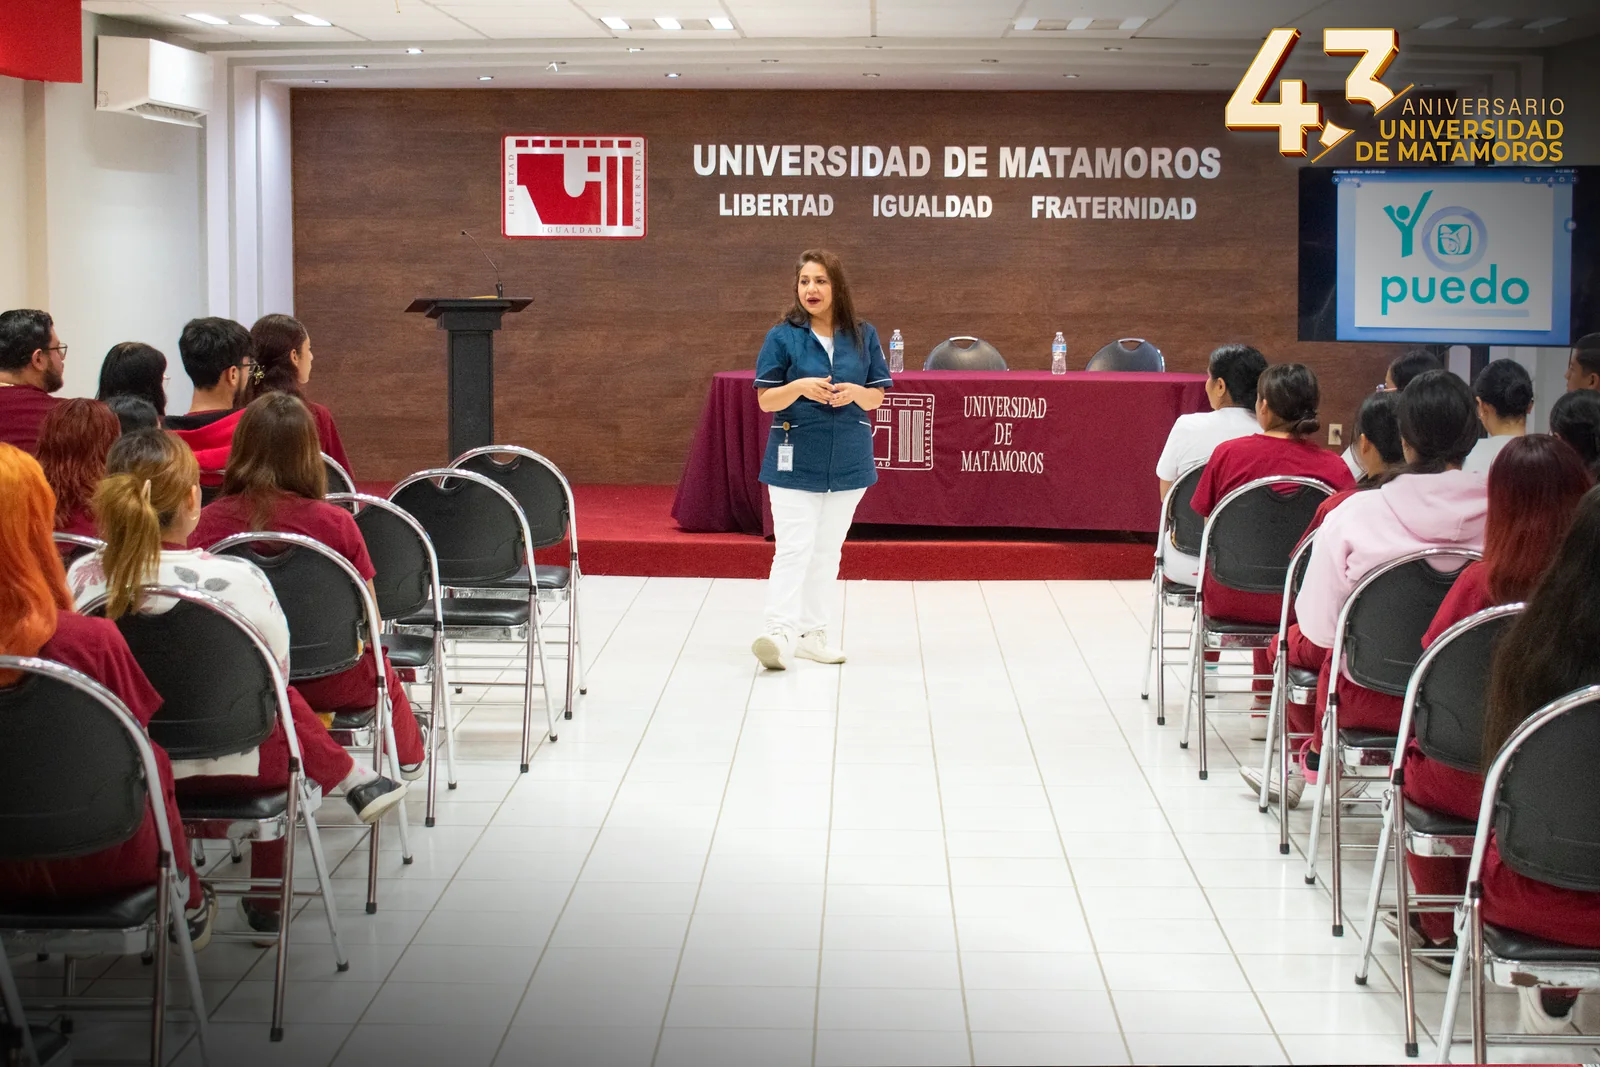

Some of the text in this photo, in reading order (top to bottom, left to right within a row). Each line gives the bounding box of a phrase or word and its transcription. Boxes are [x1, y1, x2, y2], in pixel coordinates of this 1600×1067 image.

[693, 144, 1222, 180] UNIVERSIDAD DE MATAMOROS
[719, 193, 1197, 220] LIBERTAD IGUALDAD FRATERNIDAD
[542, 226, 602, 234] IGUALDAD
[1381, 263, 1530, 316] puedo
[963, 396, 1047, 419] UNIVERSIDAD
[994, 422, 1012, 446] DE
[961, 450, 1044, 474] MATAMOROS
